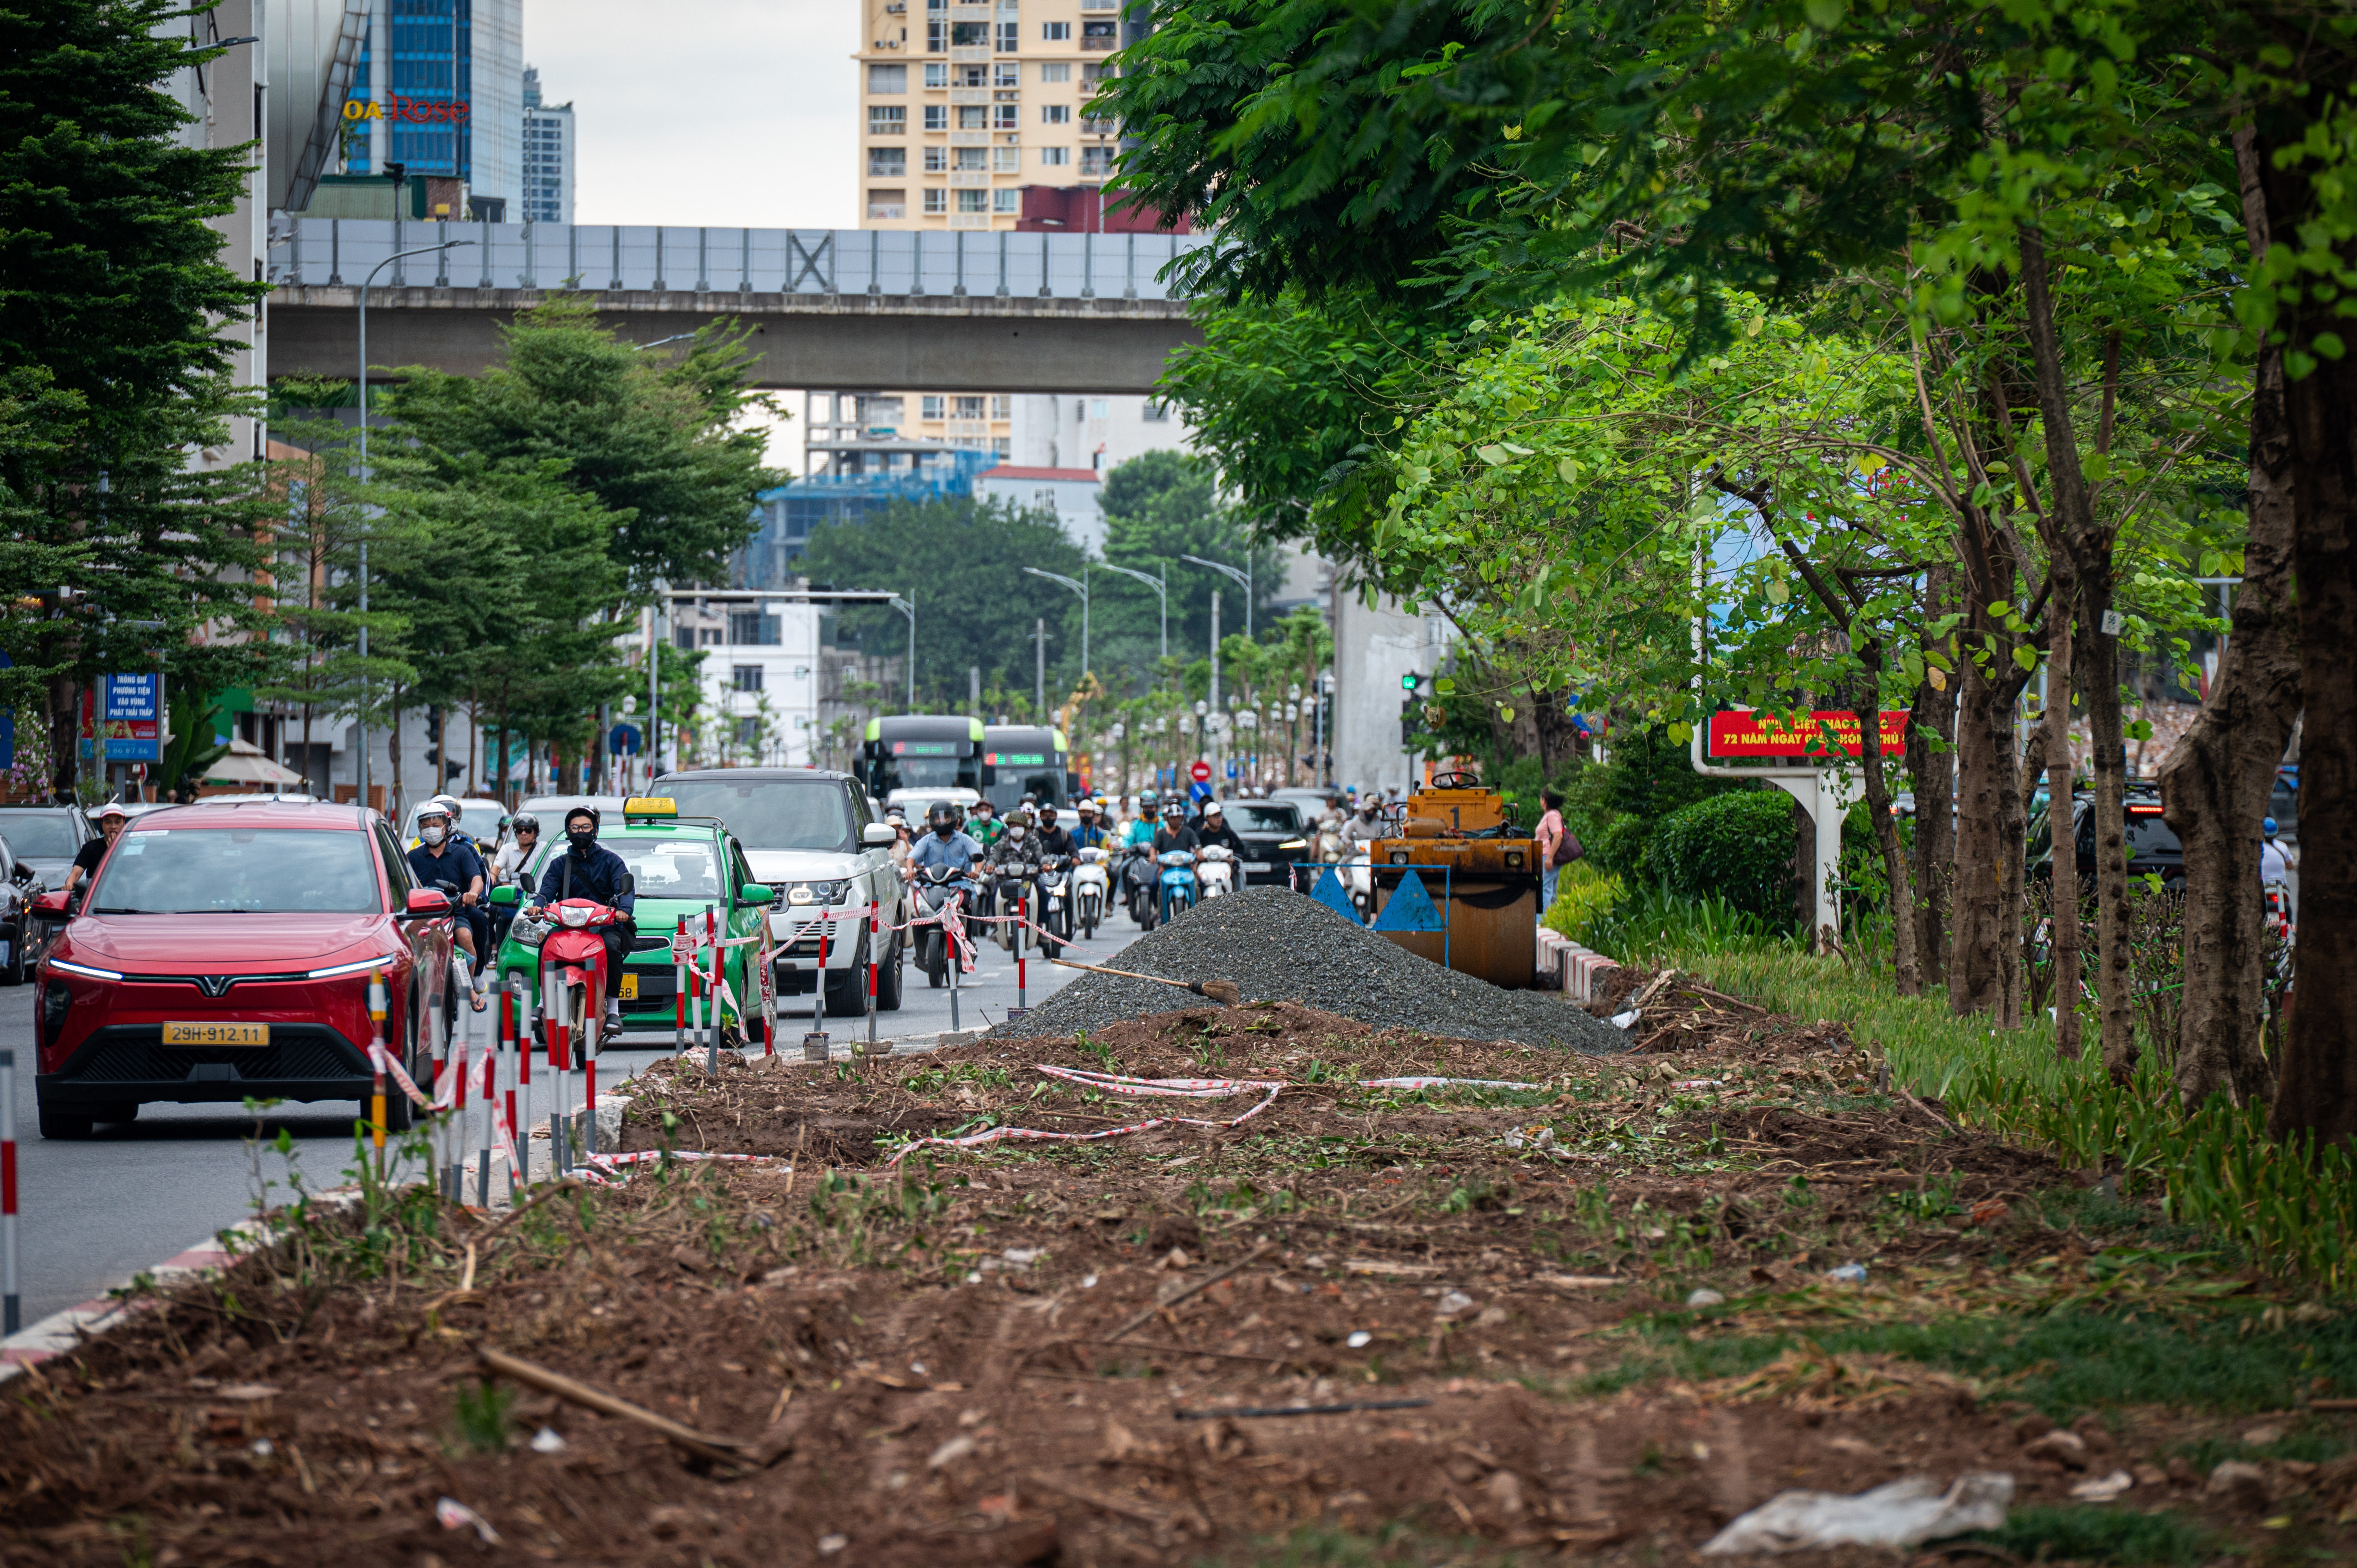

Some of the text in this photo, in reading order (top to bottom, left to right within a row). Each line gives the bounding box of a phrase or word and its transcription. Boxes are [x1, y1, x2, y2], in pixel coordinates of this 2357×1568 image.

[1819, 717, 1850, 730] HÀO
[1724, 734, 1737, 744] 72
[1741, 732, 1767, 744] NĂM
[172, 1027, 258, 1041] 29H-912.11
